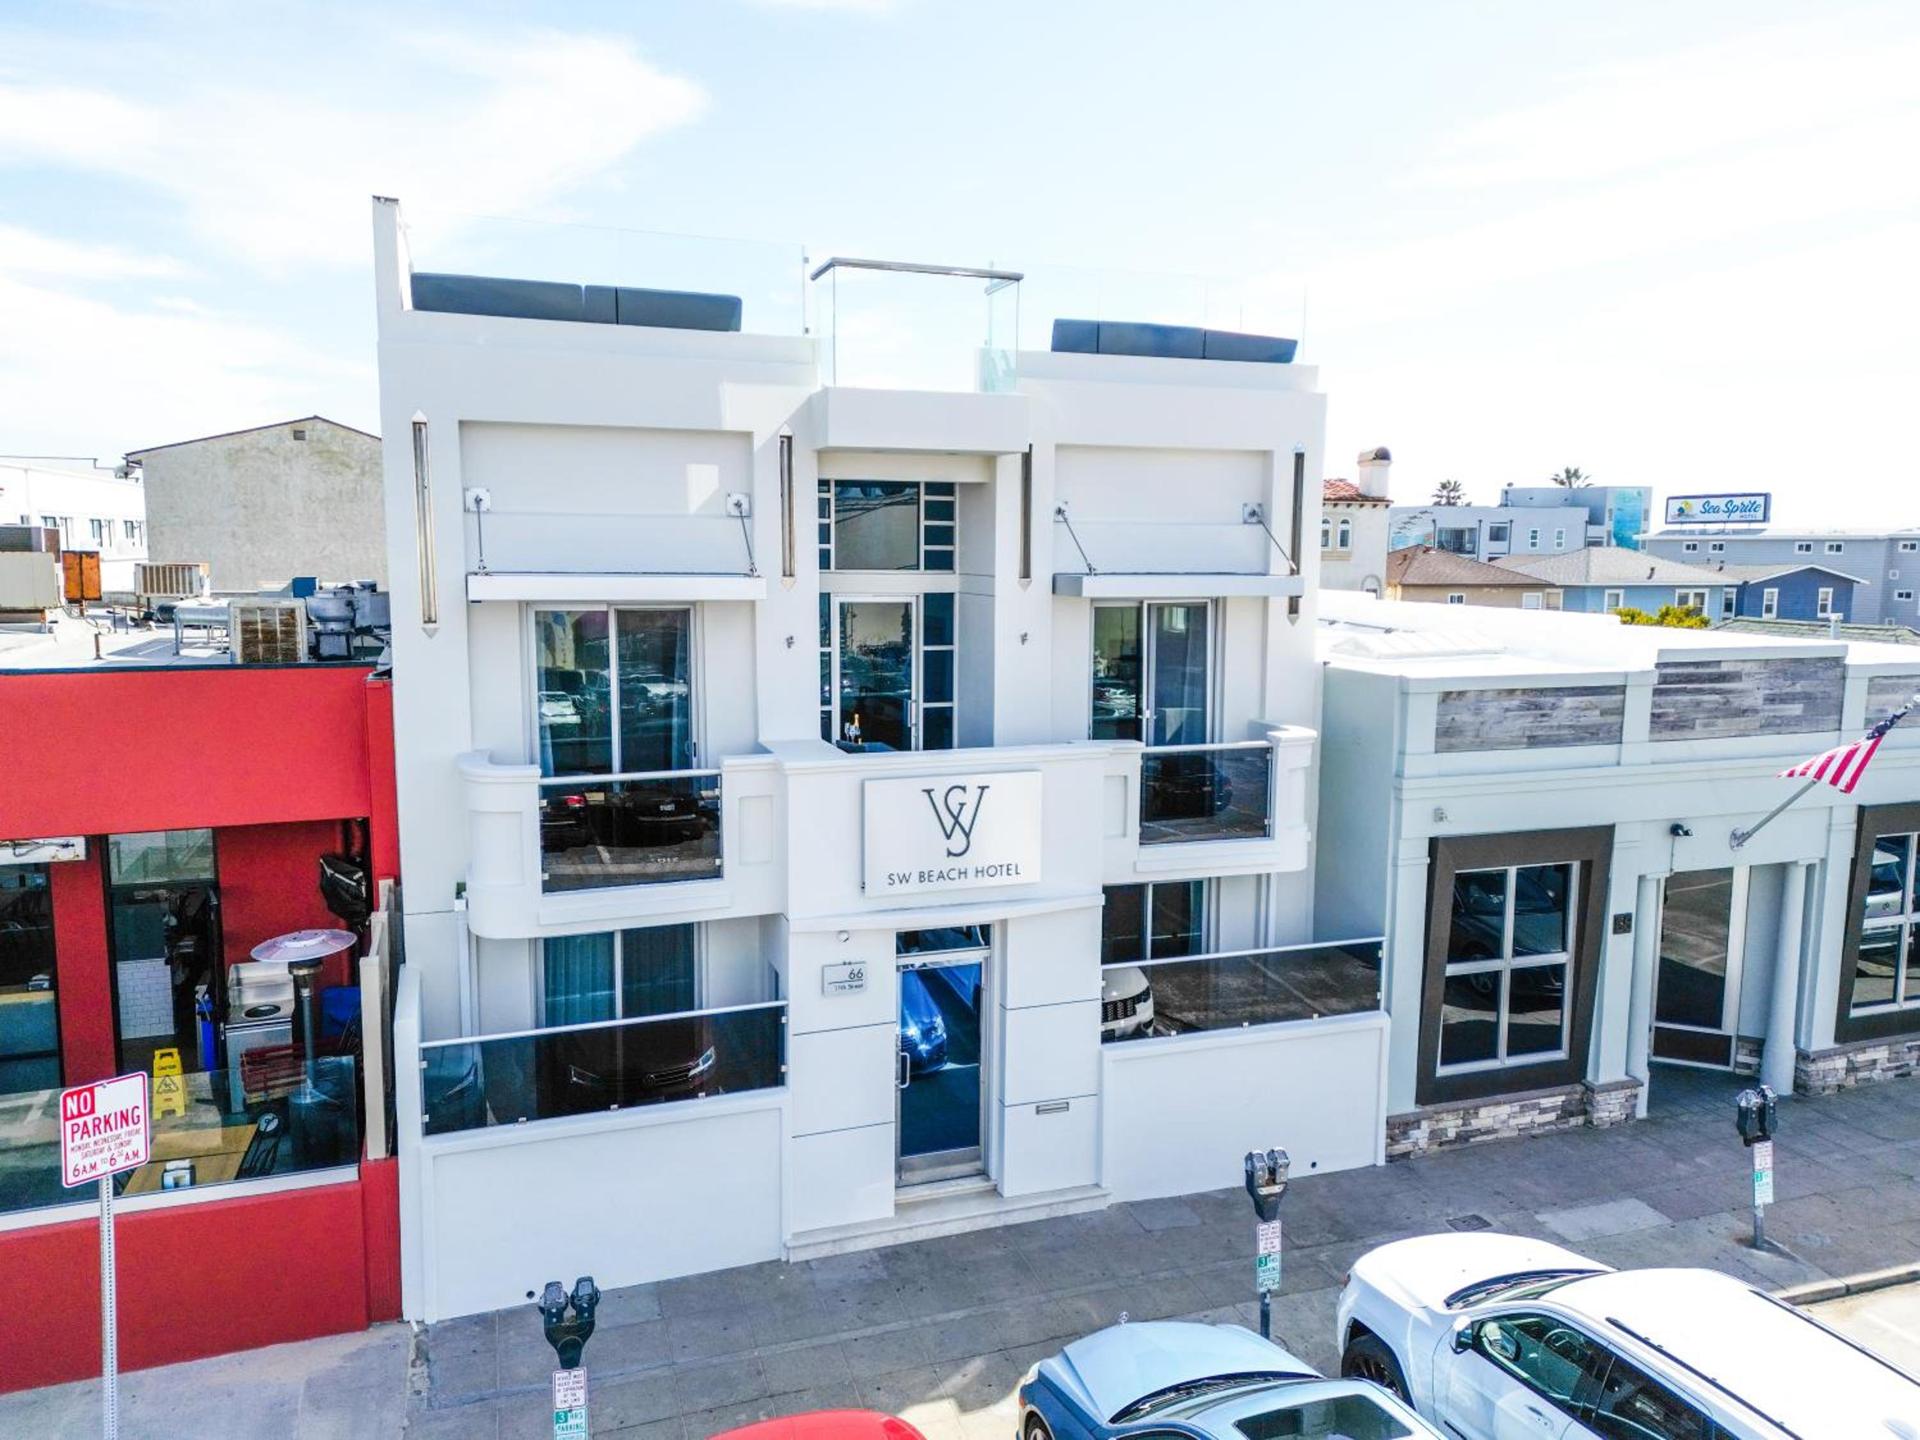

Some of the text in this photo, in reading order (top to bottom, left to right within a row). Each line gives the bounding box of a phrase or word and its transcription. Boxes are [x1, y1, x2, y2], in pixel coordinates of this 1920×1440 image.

[1700, 499, 1762, 519] Sea Sprite
[888, 863, 1021, 886] SW BEACH HOTEL
[848, 967, 864, 980] 66
[66, 1091, 92, 1119] NO
[71, 1105, 141, 1143] PARKING
[558, 1411, 566, 1423] 3
